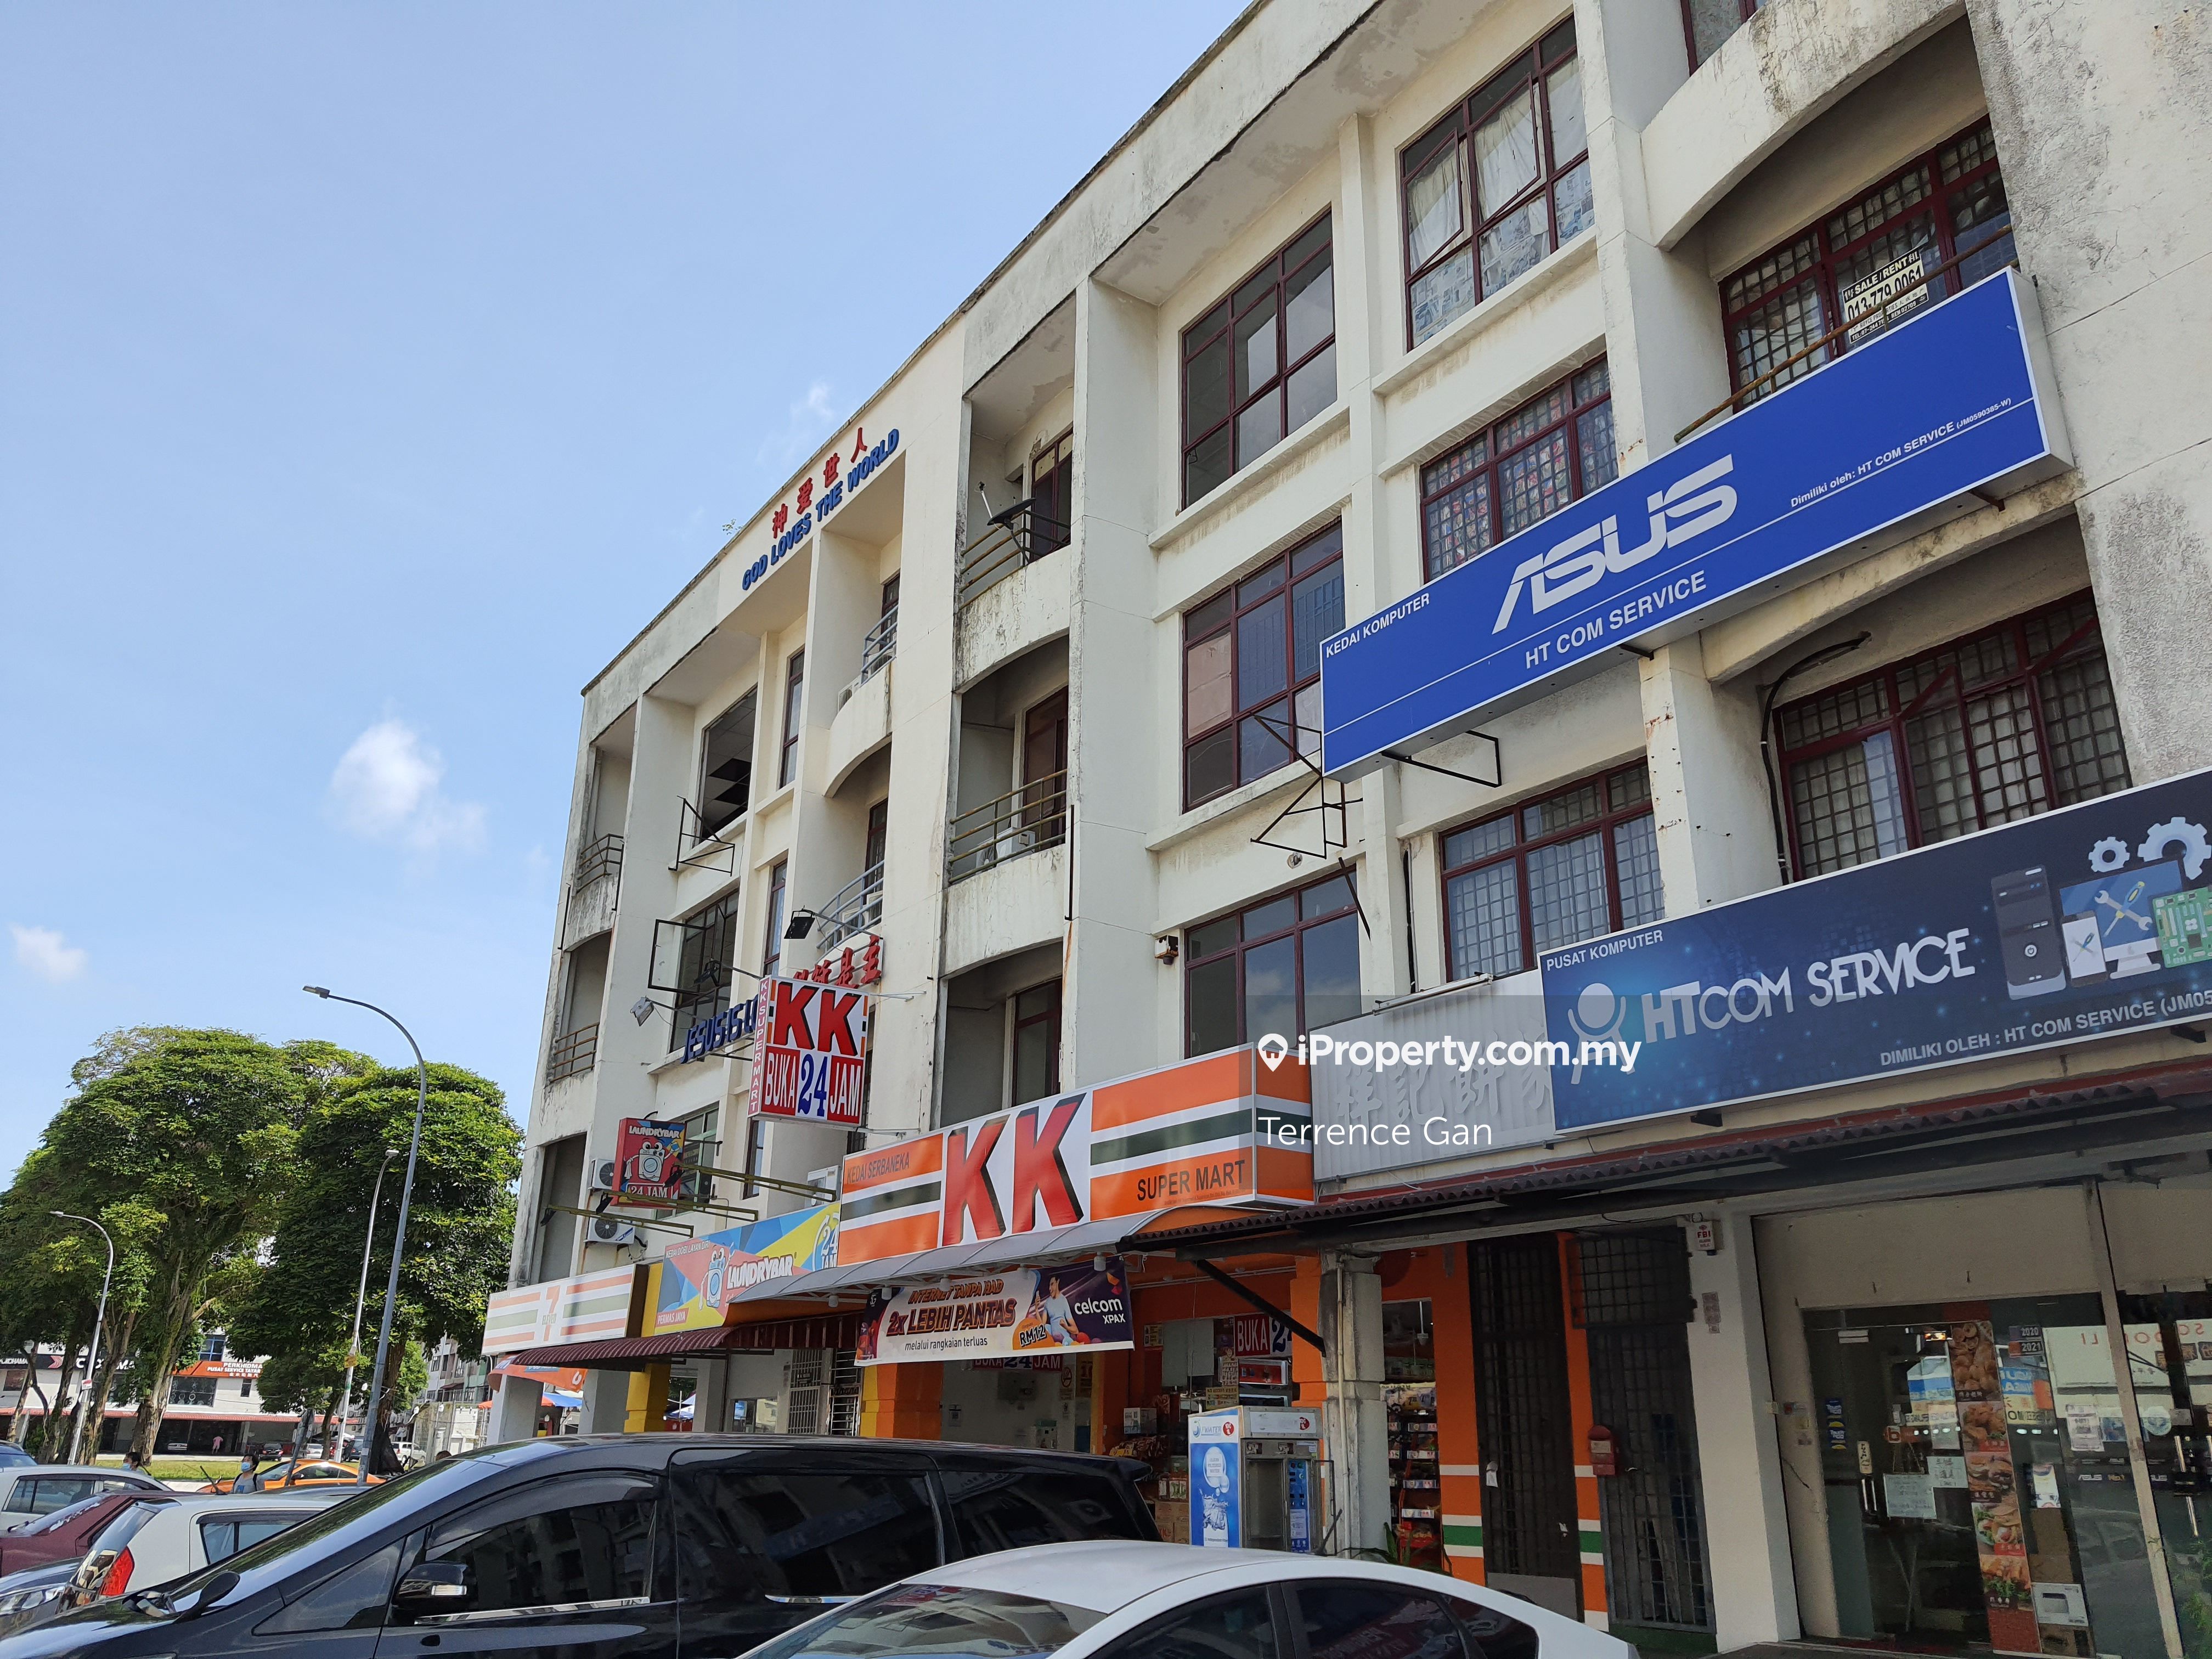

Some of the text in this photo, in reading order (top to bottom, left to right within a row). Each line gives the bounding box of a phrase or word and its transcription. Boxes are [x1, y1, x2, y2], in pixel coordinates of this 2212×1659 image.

[1855, 275, 1878, 295] SALE
[1883, 257, 1907, 279] RENT
[1791, 398, 2012, 507] Dimiliki oleh: HT COM SERVICE (JM0590385-W)
[742, 428, 899, 590] GOD LOVES THE WORLD
[1492, 454, 1737, 634] ASUS
[1325, 592, 1430, 658] KEDAI KOMPUTER
[1526, 569, 1707, 669] HT COM SERVICE
[1546, 929, 1663, 972] PUSAT KOMPUTER
[1808, 928, 1975, 1007] SERVICE
[681, 1012, 727, 1064] JESUS
[727, 1003, 746, 1042] IS
[773, 981, 862, 1057] KK
[1880, 1043, 1942, 1066] DIMILIKI
[1946, 1032, 1990, 1054] OLEH
[2004, 1026, 2026, 1043] HT
[2031, 1017, 2072, 1037] COM
[2076, 1001, 2156, 1029] SERVICE
[764, 1052, 861, 1117] BUKA 24 JAM
[629, 1125, 680, 1138] LAUNDRYBAR
[847, 1152, 909, 1184] KEDAI SERBANEKA
[942, 1092, 1087, 1247] KK
[1137, 1170, 1190, 1201] SUPER
[1196, 1160, 1245, 1190] MART
[630, 1186, 668, 1198] 24 JAM
[665, 1240, 710, 1258] KEDAI DOBI LAYAN DIRI
[821, 1224, 839, 1255] 24
[727, 1254, 793, 1289] LAUNDRYBAR
[822, 1255, 837, 1269] JAM
[953, 1282, 982, 1299] TANPA
[983, 1279, 1004, 1296] HAD
[1074, 1297, 1122, 1314] celcom
[658, 1311, 685, 1324] PERMAS JAYA
[907, 1305, 954, 1334] LEBIH
[952, 1298, 1017, 1331] PANTAS
[1103, 1314, 1125, 1324] XPAX
[2021, 1327, 2039, 1336] 2020
[905, 1336, 988, 1350] melalui rangkaian terluas
[1019, 1324, 1047, 1347] RM12
[1237, 1318, 1268, 1352] BUKA
[2021, 1342, 2041, 1352] 2021
[1034, 1356, 1060, 1368] JAM
